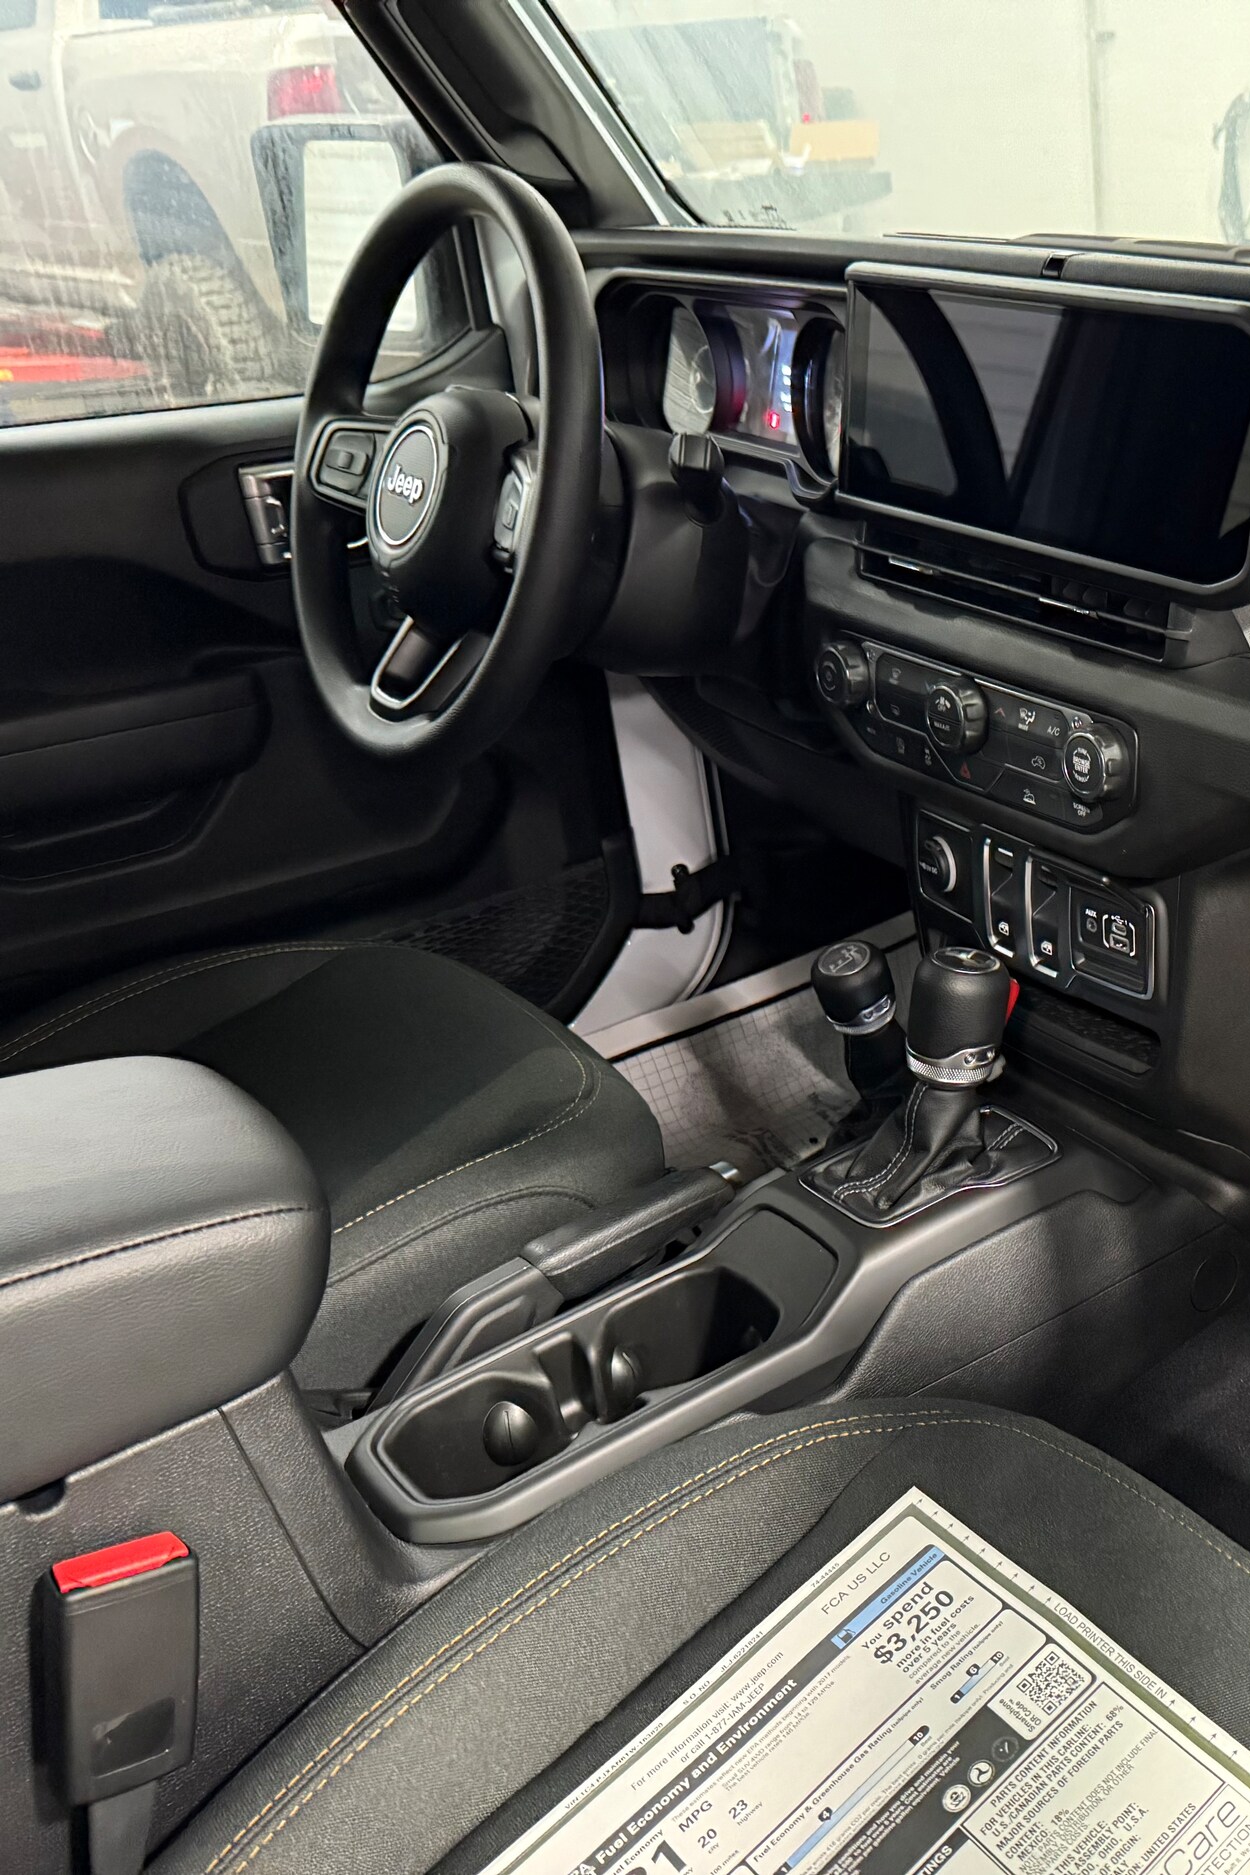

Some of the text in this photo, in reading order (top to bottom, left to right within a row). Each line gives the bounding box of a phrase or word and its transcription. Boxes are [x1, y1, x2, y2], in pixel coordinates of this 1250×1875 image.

[388, 464, 423, 503] Jeep
[1047, 725, 1060, 736] A/C
[1085, 908, 1097, 918] AUX
[821, 1551, 890, 1614] FCA US LLC
[880, 1553, 937, 1604] Gasoline Vehicle
[861, 1581, 934, 1649] You spend
[873, 1590, 953, 1663] $3,250
[896, 1595, 974, 1668] more in fuel costs
[902, 1622, 956, 1672] over 5 years
[908, 1630, 960, 1679] compared to the
[915, 1623, 980, 1684] average new vehicle.
[930, 1650, 973, 1689] Smog Rating
[969, 1666, 978, 1674] 6
[992, 1651, 1003, 1661] 10
[1053, 1602, 1167, 1698] LOAD PRINTER THIS SIDE IN
[630, 1777, 645, 1790] For
[646, 1757, 668, 1777] more
[667, 1718, 712, 1758] information
[711, 1701, 731, 1718] visit:
[730, 1651, 783, 1701] www.jeep.com
[678, 1682, 764, 1763] or call 1-877-IAM-JEEP
[912, 1730, 924, 1742] 10
[999, 1698, 1035, 1732] Smartphone
[1025, 1711, 1041, 1725] QR
[593, 1831, 630, 1864] Fuel
[623, 1774, 694, 1837] Economy
[687, 1751, 718, 1779] and
[713, 1677, 799, 1755] Environment
[979, 1724, 1091, 1835] FOR VEHICLES IN THIS CARLINE:
[989, 1705, 1123, 1837] U.S./CANADIAN PARTS CONTENT: 68%
[990, 1700, 1097, 1807] PARTS CONTENT INFORMATION
[753, 1844, 771, 1862] Fuel
[770, 1812, 805, 1846] Economy
[812, 1763, 854, 1805] Greenhouse
[852, 1746, 872, 1764] Gas
[867, 1727, 892, 1749] Rating
[995, 1821, 1025, 1851] MAJOR
[1022, 1786, 1058, 1823] SOURCES
[1054, 1774, 1071, 1789] OF
[1067, 1743, 1100, 1777] FOREIGN
[1097, 1720, 1123, 1745] PARTS
[1037, 1829, 1062, 1852] PARTS
[1058, 1800, 1091, 1831] CONTENT
[1085, 1784, 1104, 1803] DOES
[1101, 1770, 1118, 1785] NOT
[1114, 1744, 1142, 1772] INCLUDE
[1139, 1728, 1158, 1746] FINAL
[1057, 1795, 1106, 1841] DISTRIBUTION,
[1102, 1784, 1114, 1795] OR
[1111, 1763, 1134, 1785] OTHER
[678, 1800, 712, 1832] MPG
[697, 1799, 747, 1848] 20 23
[736, 1801, 762, 1825] highway
[819, 1809, 831, 1820] 4
[1017, 1828, 1050, 1861] MEXICO:
[1050, 1808, 1069, 1825] 18%
[1074, 1827, 1113, 1869] ASSEMBLY
[1111, 1802, 1139, 1828] POINT:
[1098, 1837, 1122, 1859] OHIO,
[1122, 1808, 1149, 1831] U.S.A.
[1140, 1802, 1196, 1861] UNITED STATES
[623, 1829, 663, 1865] Economy
[1005, 1821, 1043, 1859] CONTENT:
[1054, 1853, 1075, 1873] THIS
[1072, 1820, 1108, 1854] VEHICLE:
[1099, 1863, 1110, 1875] OF
[1110, 1834, 1141, 1864] ORIGIN:
